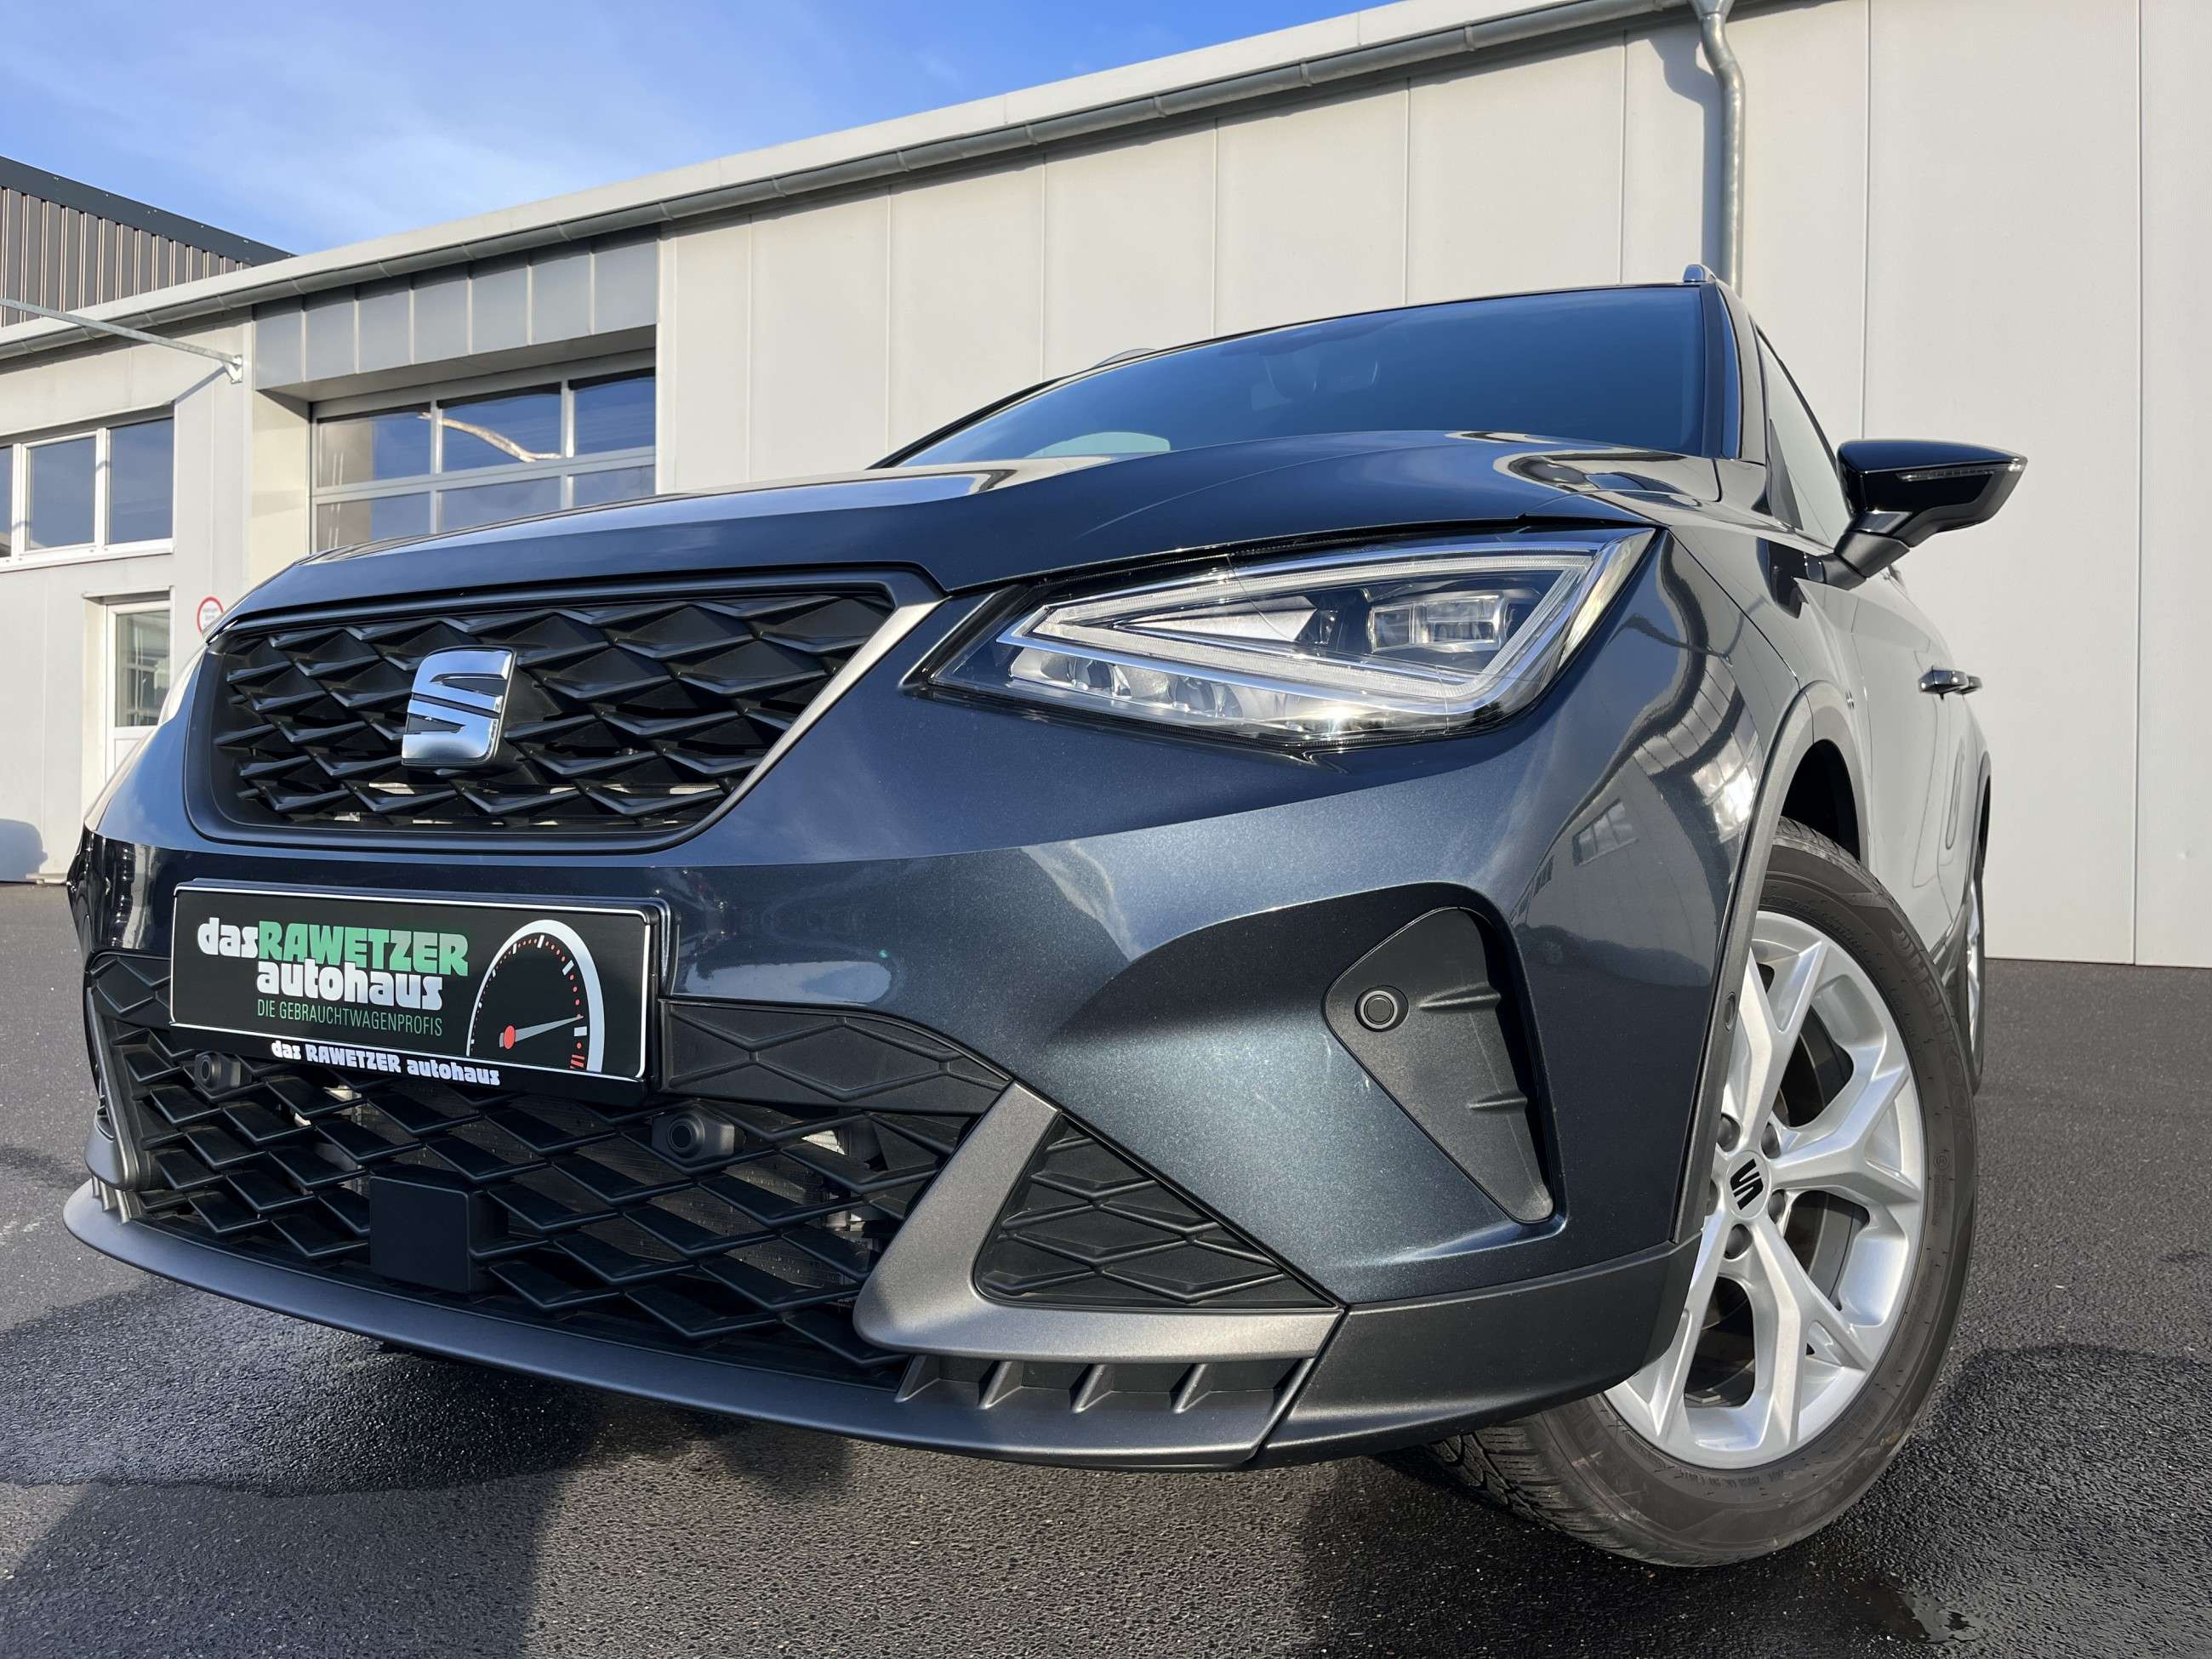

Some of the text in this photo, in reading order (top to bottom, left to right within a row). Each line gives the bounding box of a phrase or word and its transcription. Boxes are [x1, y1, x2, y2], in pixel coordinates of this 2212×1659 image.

[257, 958, 443, 1011] autohaus
[258, 999, 442, 1037] DIE GEBRAUCHTWAGENPROFIS
[271, 1040, 500, 1086] das RAWETZER autohaus
